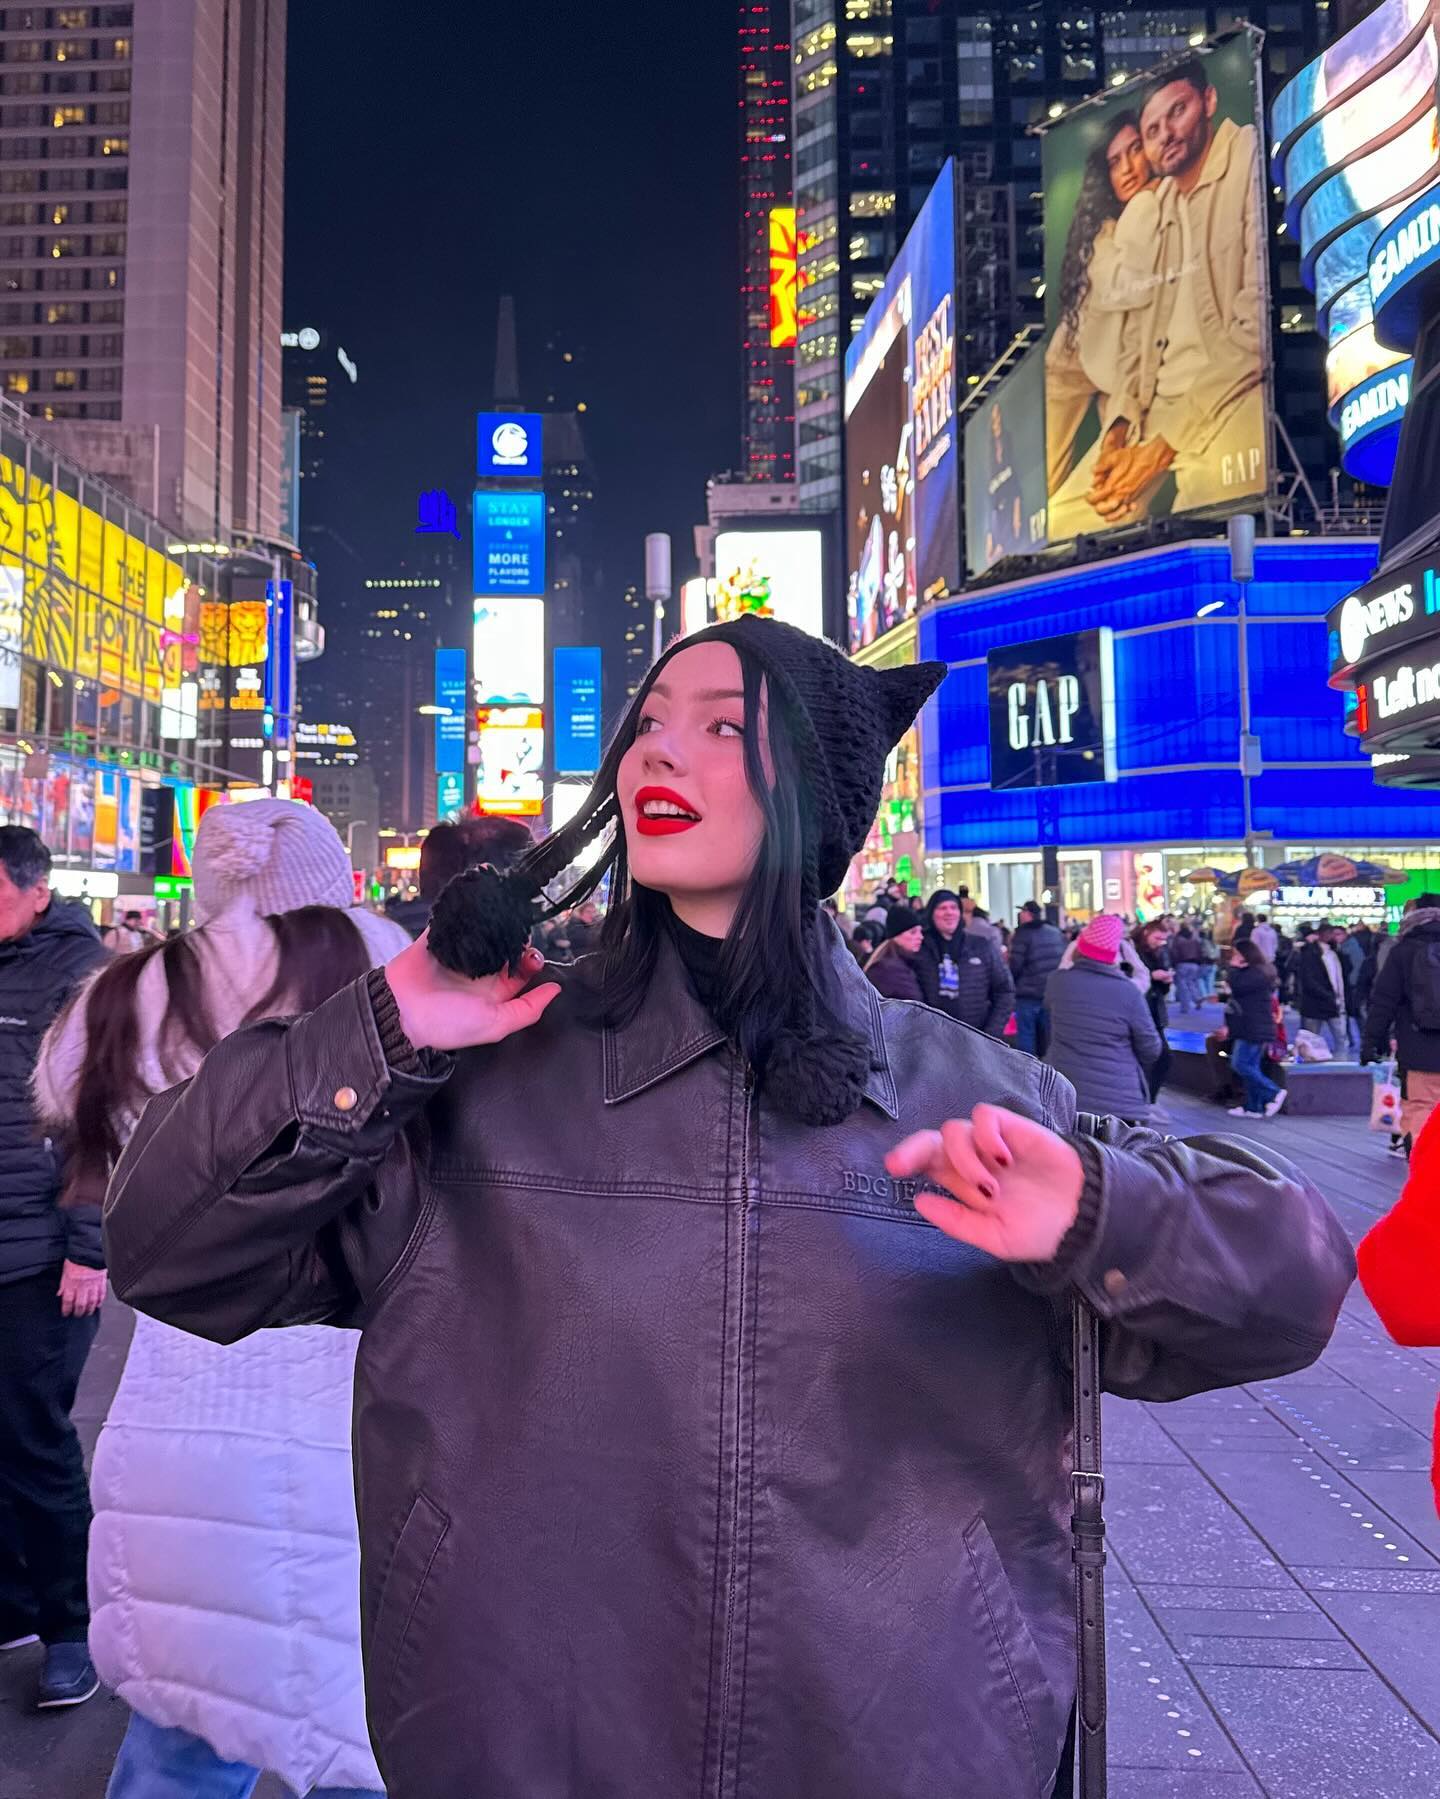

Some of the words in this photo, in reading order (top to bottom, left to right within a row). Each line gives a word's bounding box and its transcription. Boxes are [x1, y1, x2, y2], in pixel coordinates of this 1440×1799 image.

[1221, 447, 1261, 486] GAP
[488, 553, 529, 565] MORE
[117, 559, 145, 599] THE
[1361, 583, 1415, 640] NEWS
[1008, 674, 1080, 750] GAP
[842, 1170, 888, 1198] BDG
